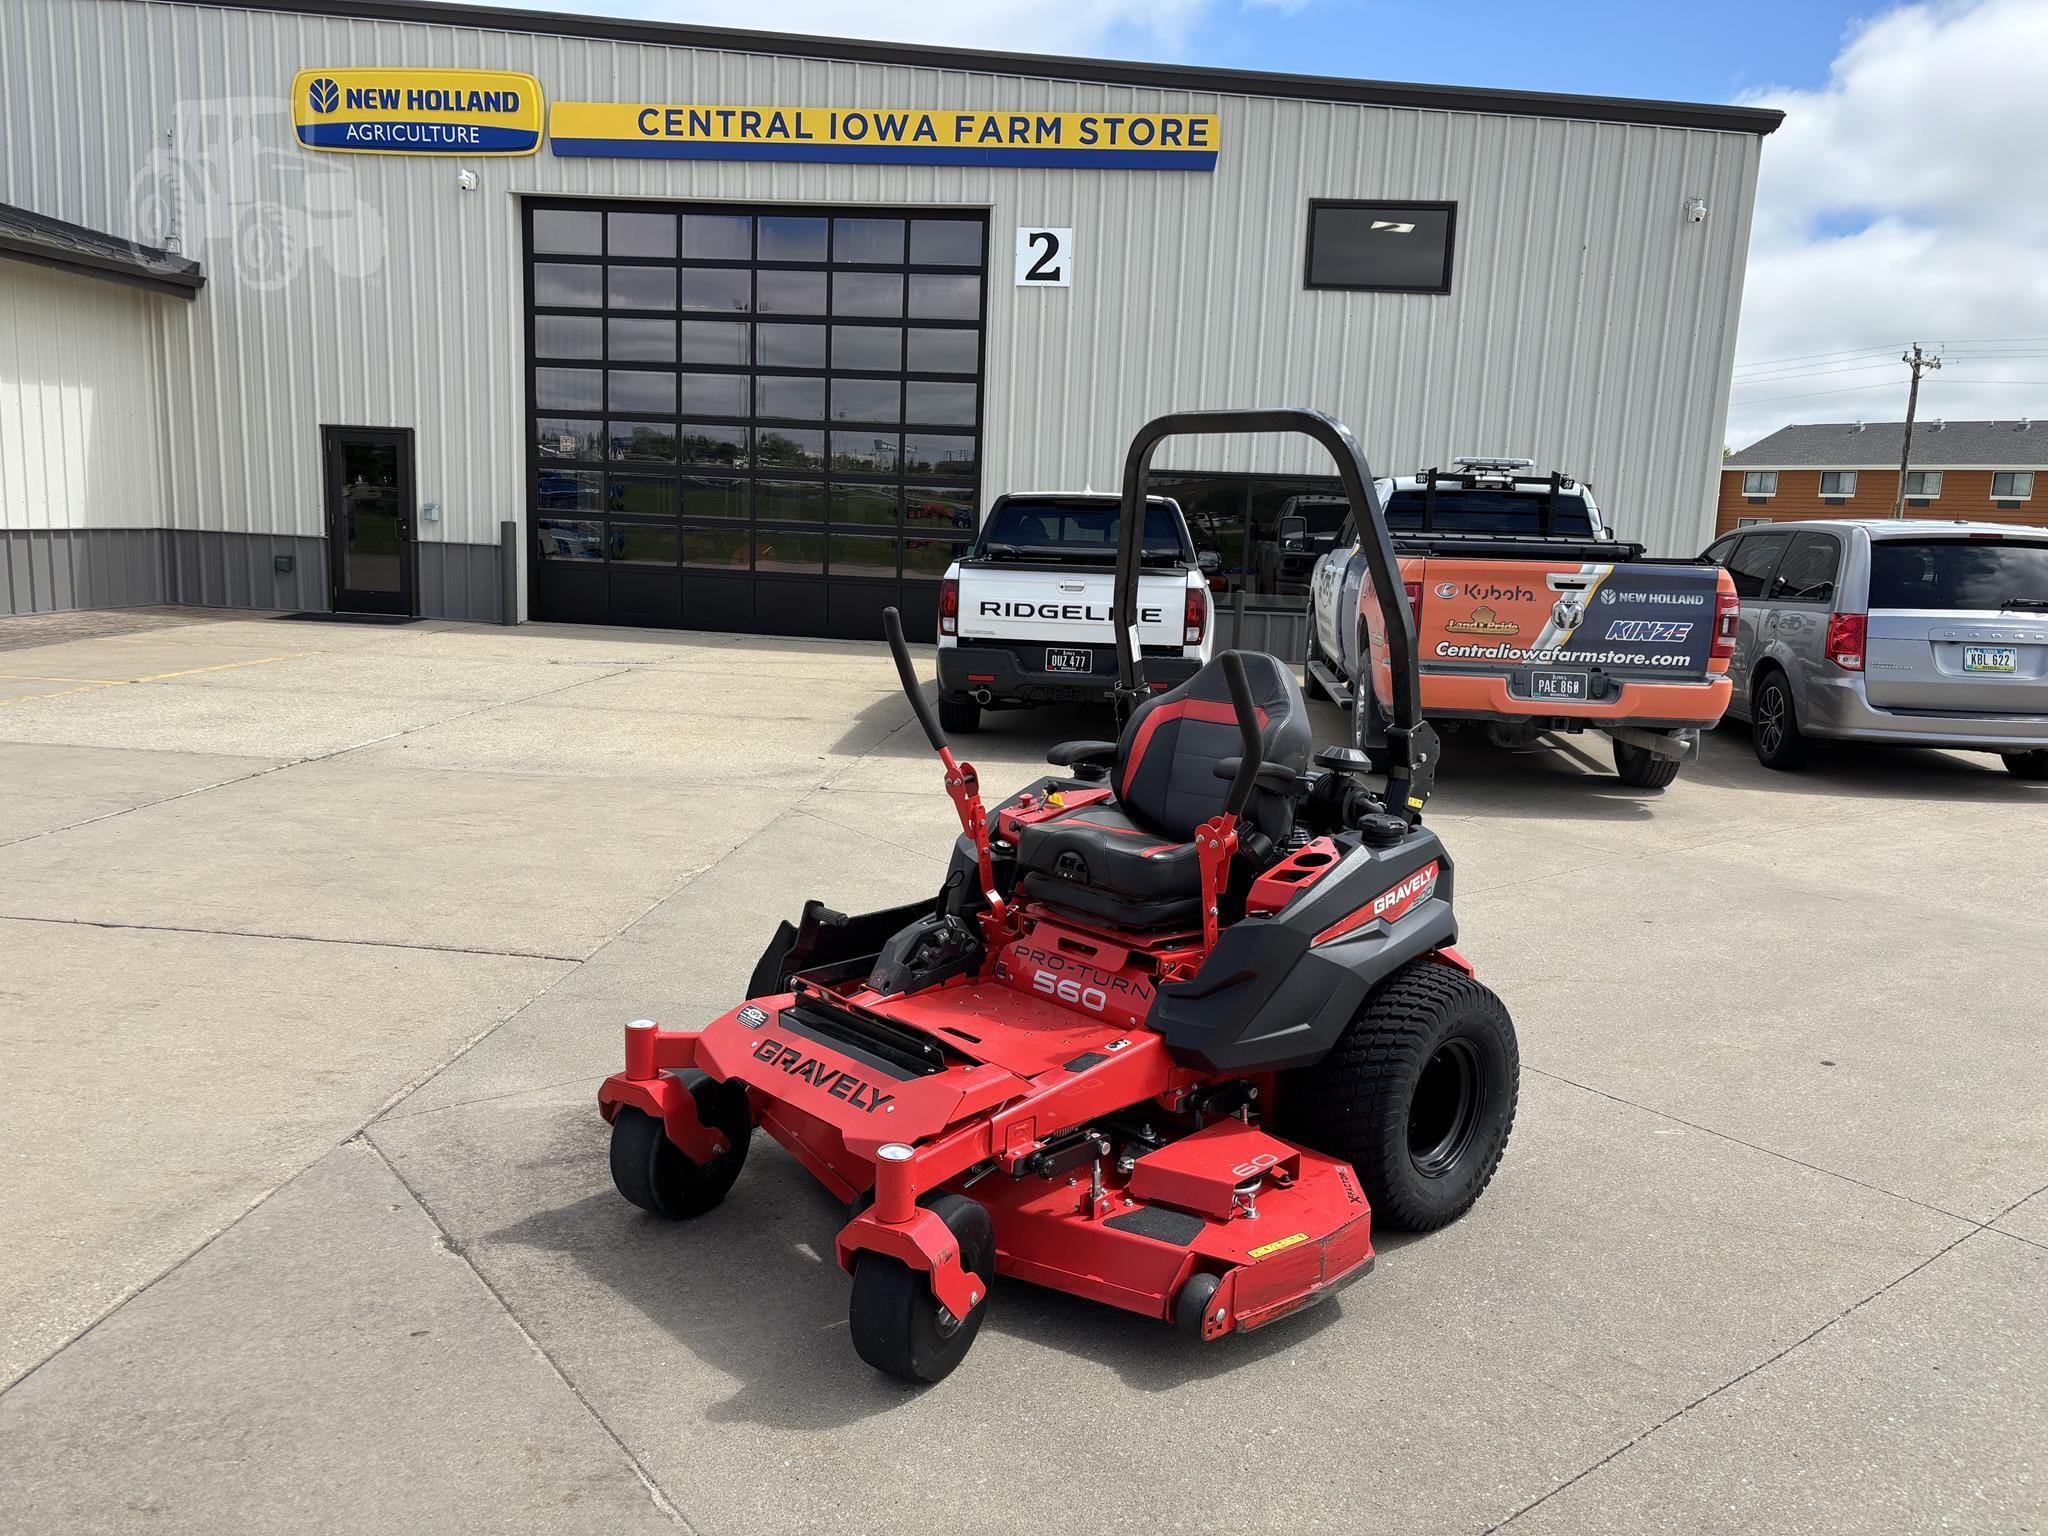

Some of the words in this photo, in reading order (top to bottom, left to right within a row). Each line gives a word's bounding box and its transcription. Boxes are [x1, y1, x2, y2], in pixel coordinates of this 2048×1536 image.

[346, 88, 401, 110] NEW
[407, 89, 520, 113] HOLLAND
[346, 124, 480, 144] AGRICULTURE
[637, 108, 813, 140] CENTRAL
[829, 112, 938, 142] IOWA
[954, 115, 1062, 145] FARM
[1079, 117, 1209, 147] STORE
[1025, 231, 1061, 282] 2
[1464, 583, 1534, 602] Kubota
[1619, 592, 1647, 603] NEW
[1649, 594, 1704, 605] HOLLAND
[979, 601, 1162, 623] RIDGELIE
[1605, 620, 1694, 643] KINZE
[1069, 655, 1086, 668] 477
[1435, 641, 1691, 667] Centraliowafarmstore.com
[1971, 653, 1989, 666] KBL
[1993, 654, 2010, 667] 622
[1538, 679, 1558, 693] PAE
[1373, 865, 1434, 915] GRAVELY
[1014, 945, 1151, 1001] PRO-TURN
[1033, 969, 1107, 1012] 560
[752, 1038, 896, 1114] GRAVELY
[1232, 1153, 1279, 1177] 60
